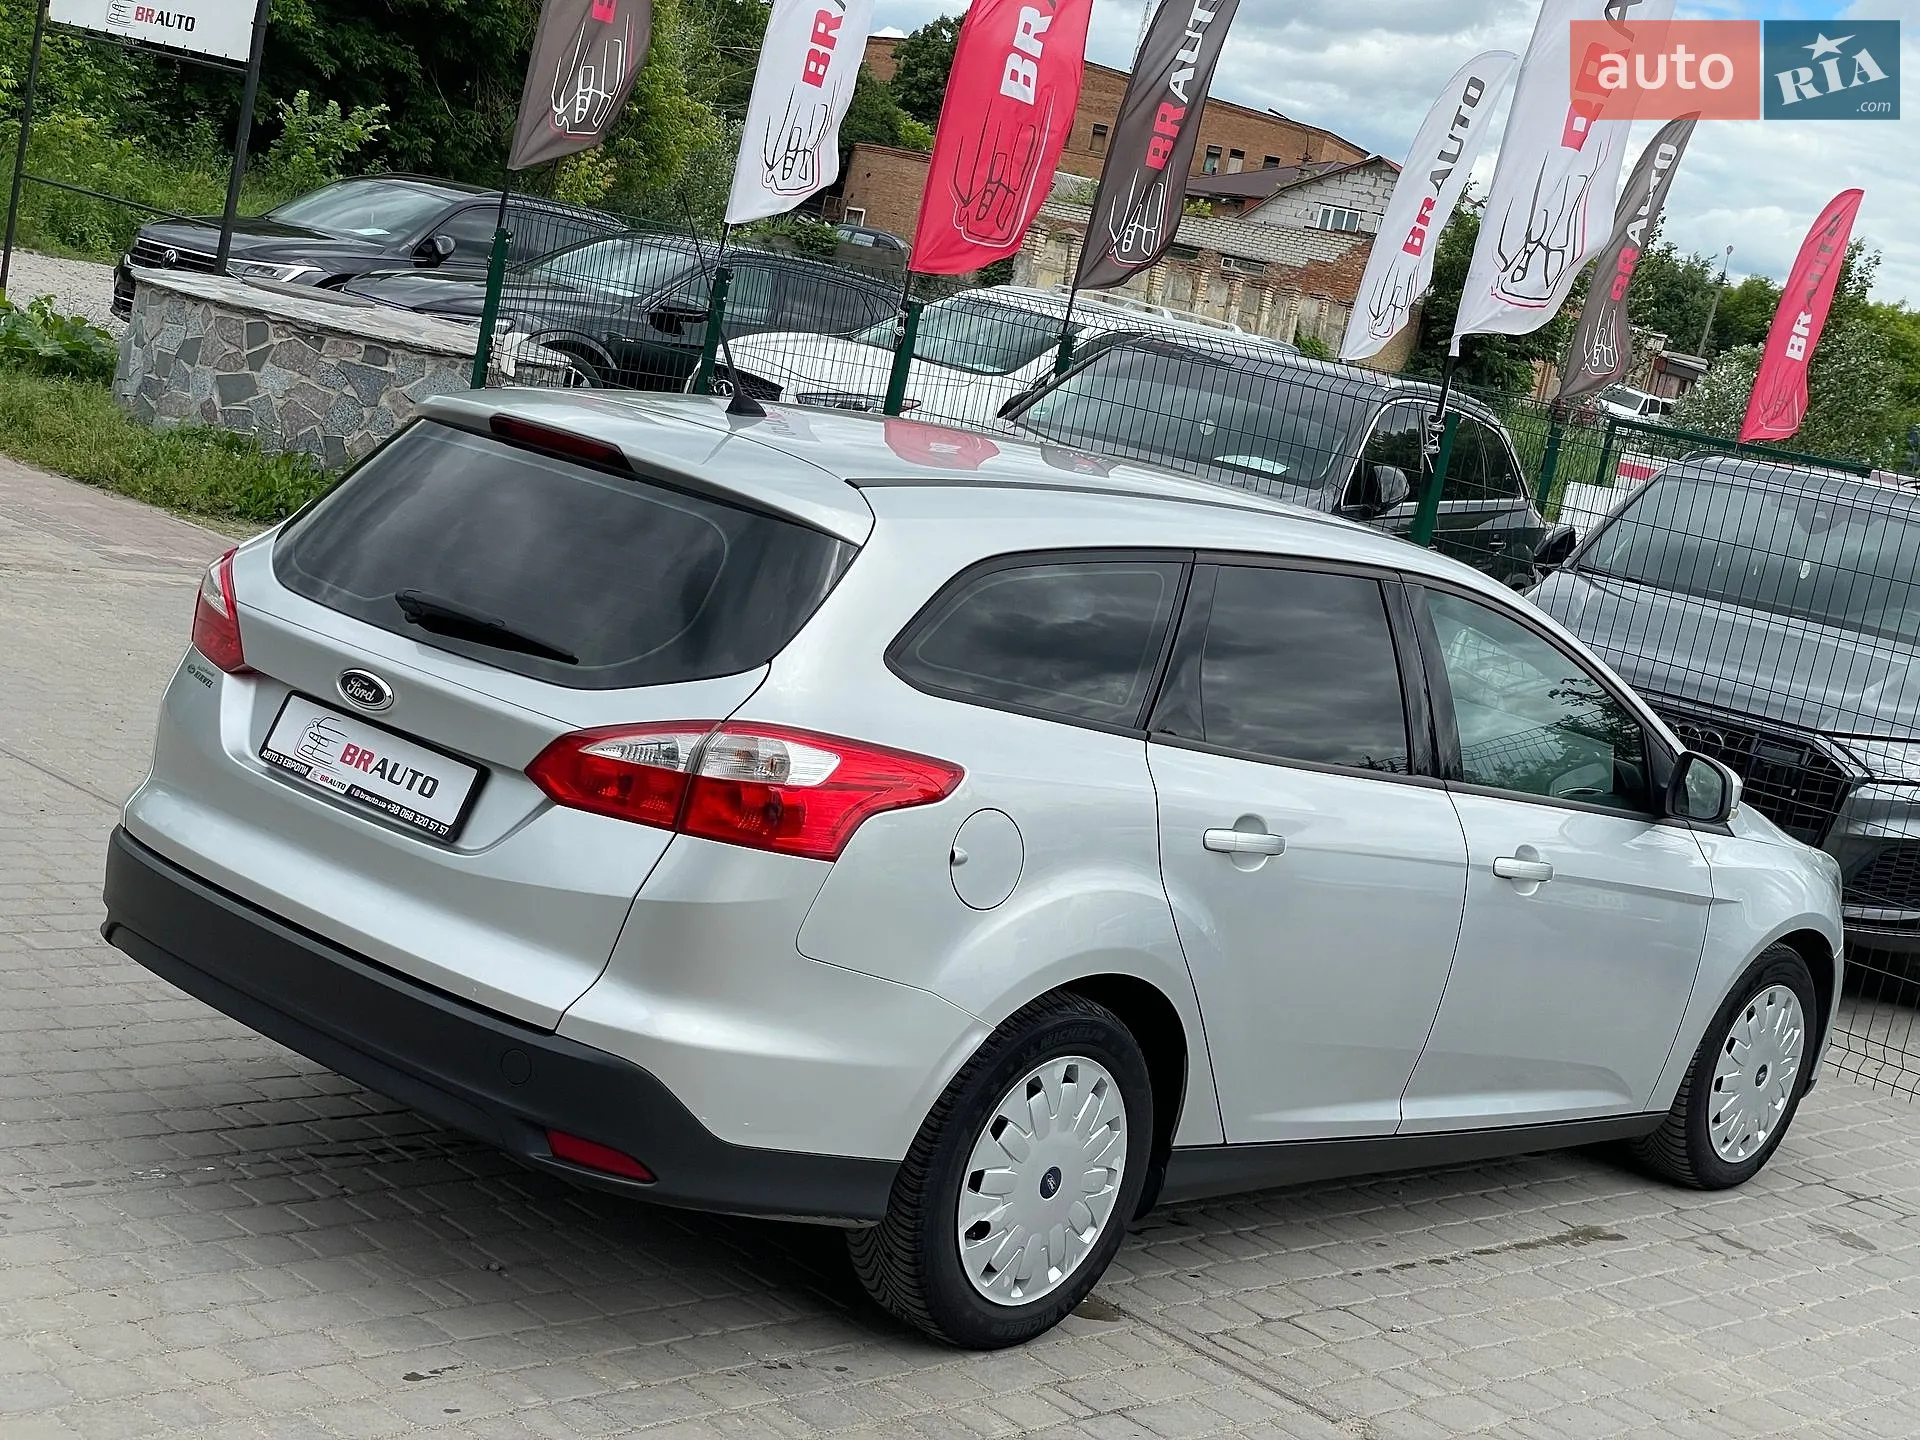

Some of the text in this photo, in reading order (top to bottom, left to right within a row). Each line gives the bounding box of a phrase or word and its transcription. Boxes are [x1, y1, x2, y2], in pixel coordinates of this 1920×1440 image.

[134, 5, 196, 32] BRAUTO
[802, 0, 846, 88] BR
[1000, 0, 1056, 106] BR
[1402, 76, 1485, 257] BRAUTO
[346, 676, 376, 702] Ford
[319, 774, 347, 791] BRAUTO
[339, 743, 439, 799] BRAUTO
[387, 803, 400, 815] +38
[400, 808, 415, 821] 068
[413, 814, 429, 828] 320
[428, 821, 439, 832] 57
[438, 825, 450, 836] 57
